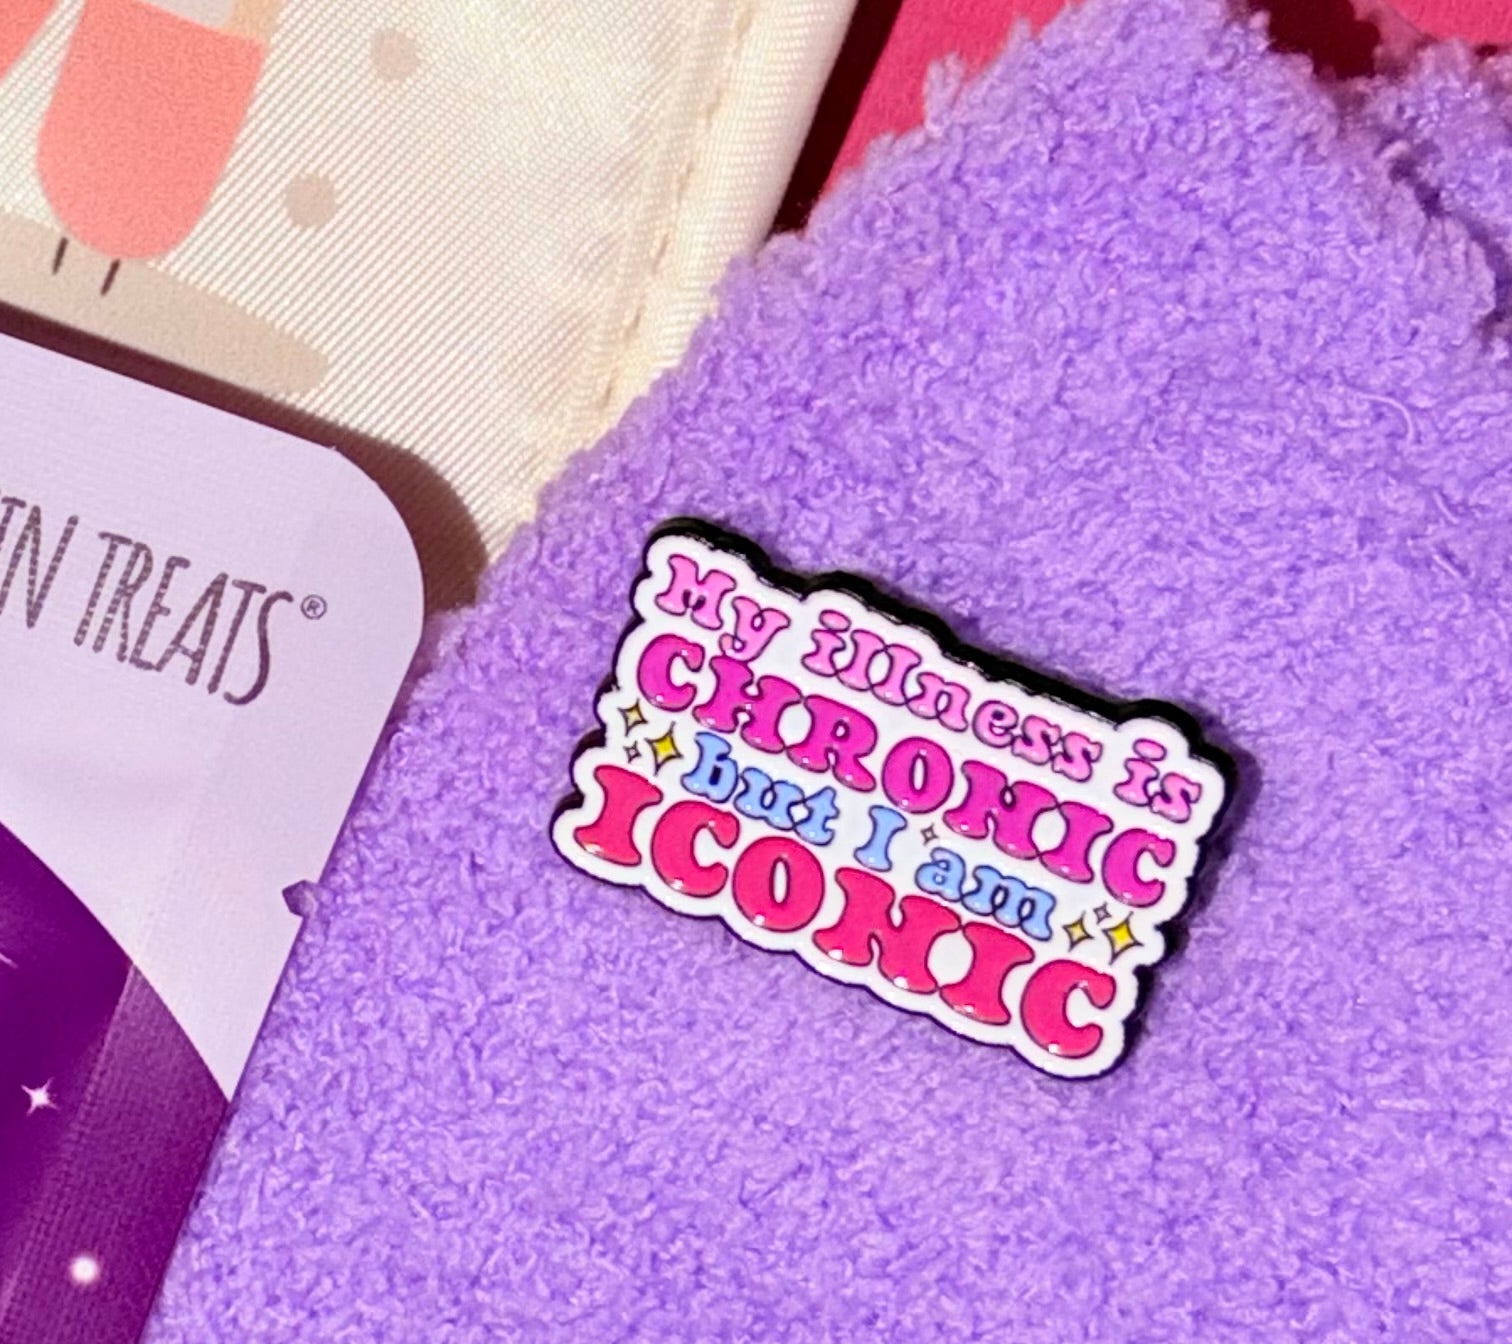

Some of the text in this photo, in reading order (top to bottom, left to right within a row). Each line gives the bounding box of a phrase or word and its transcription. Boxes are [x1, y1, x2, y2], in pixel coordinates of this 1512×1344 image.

[637, 633, 1177, 907] CHRONIC
[654, 554, 1203, 822] My illness is
[574, 765, 1117, 1058] ICONIC
[681, 732, 1056, 940] but I am
